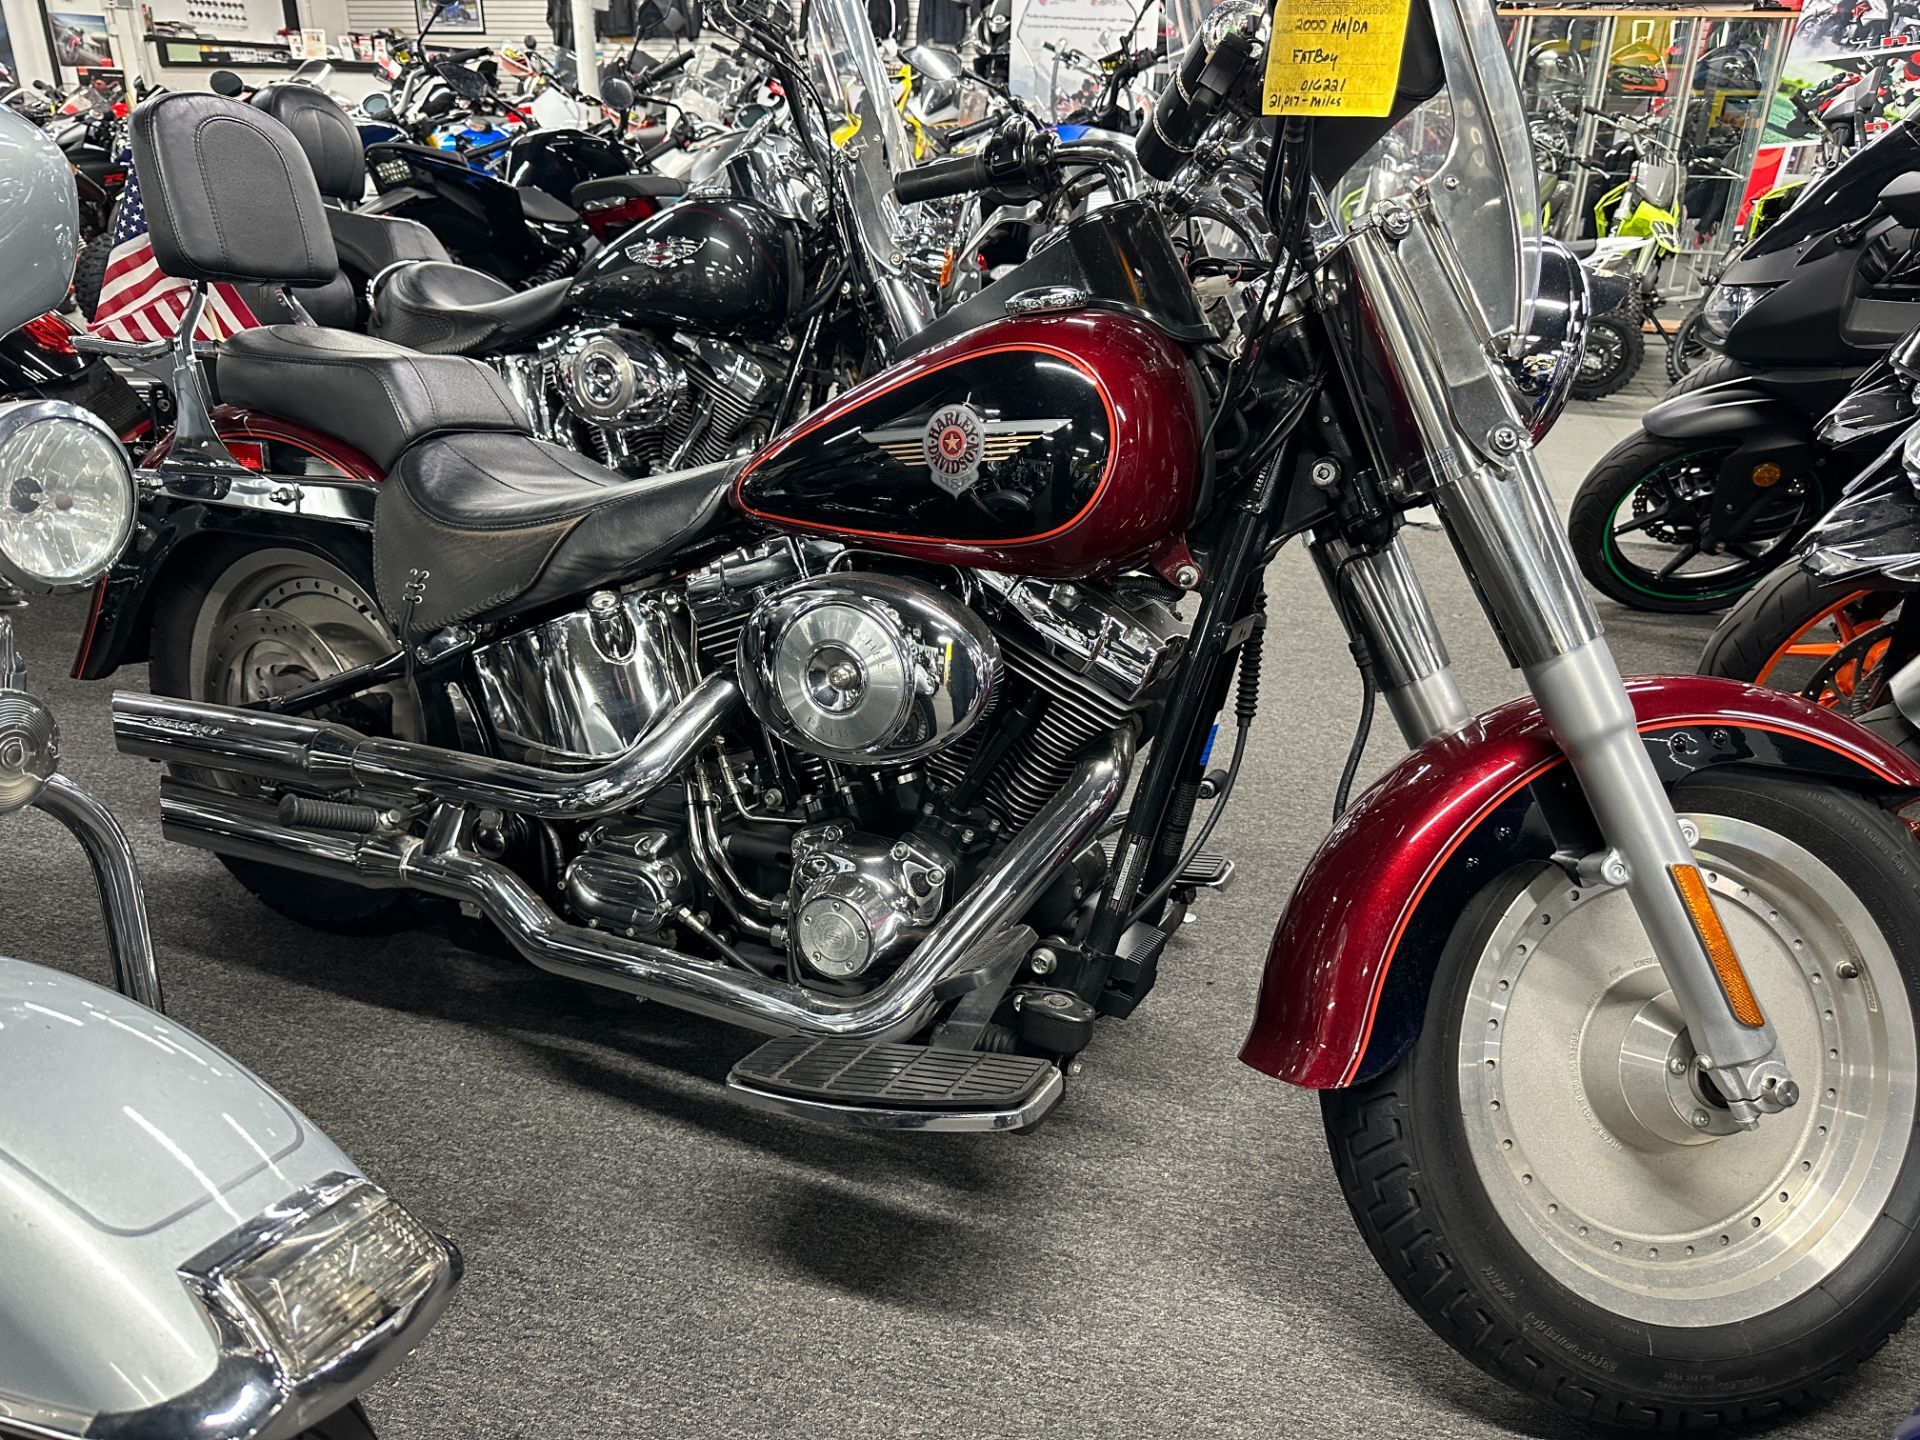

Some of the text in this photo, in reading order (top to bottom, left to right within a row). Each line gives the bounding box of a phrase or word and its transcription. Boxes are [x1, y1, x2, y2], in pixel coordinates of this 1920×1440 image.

[1295, 19, 1327, 31] 2000
[928, 411, 979, 474] HARLEY DAVIDSON
